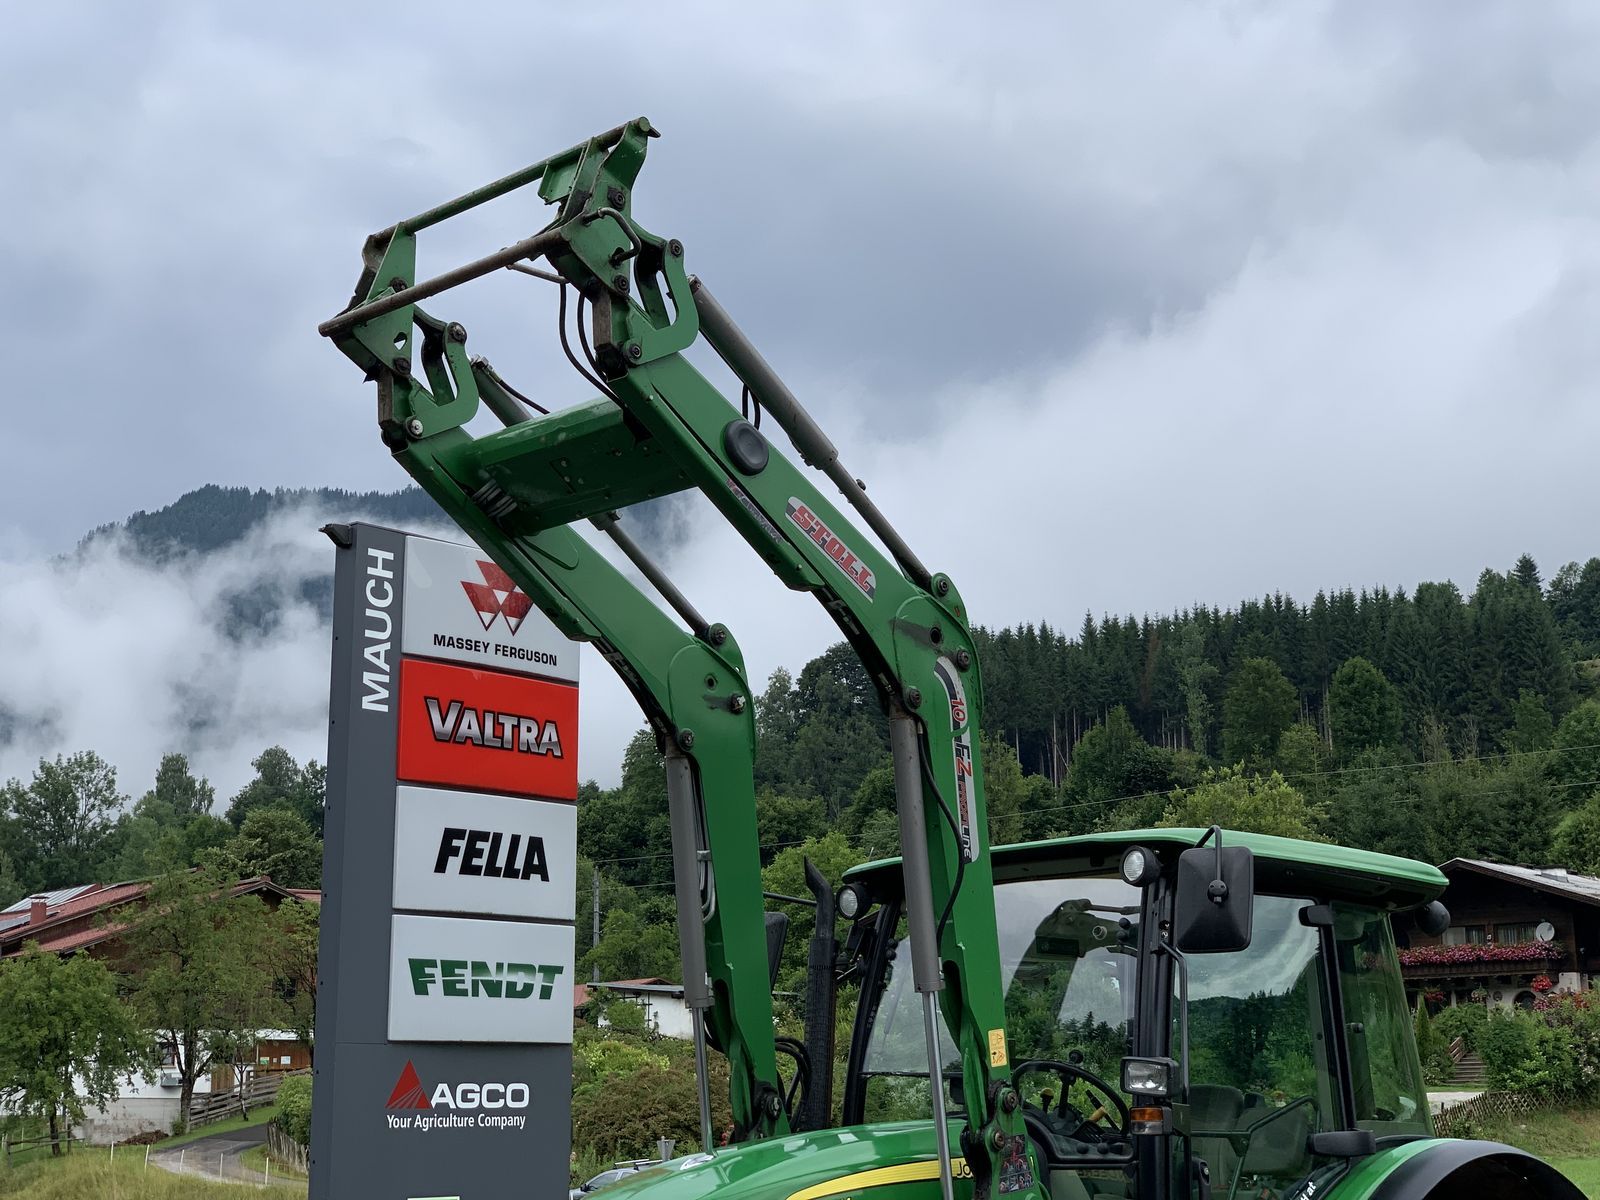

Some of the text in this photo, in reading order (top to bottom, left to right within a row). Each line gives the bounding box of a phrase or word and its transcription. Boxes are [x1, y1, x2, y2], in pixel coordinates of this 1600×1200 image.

[791, 505, 872, 592] STOLL
[361, 547, 395, 713] MAUCH
[433, 633, 558, 667] MASSEY FERGUSON
[424, 696, 564, 759] VALTRA
[955, 741, 972, 777] FZ
[433, 827, 550, 882] FELLA
[407, 957, 564, 1000] FENDT
[430, 1082, 530, 1109] AGCO
[386, 1112, 526, 1132] Your Agriculture Company
